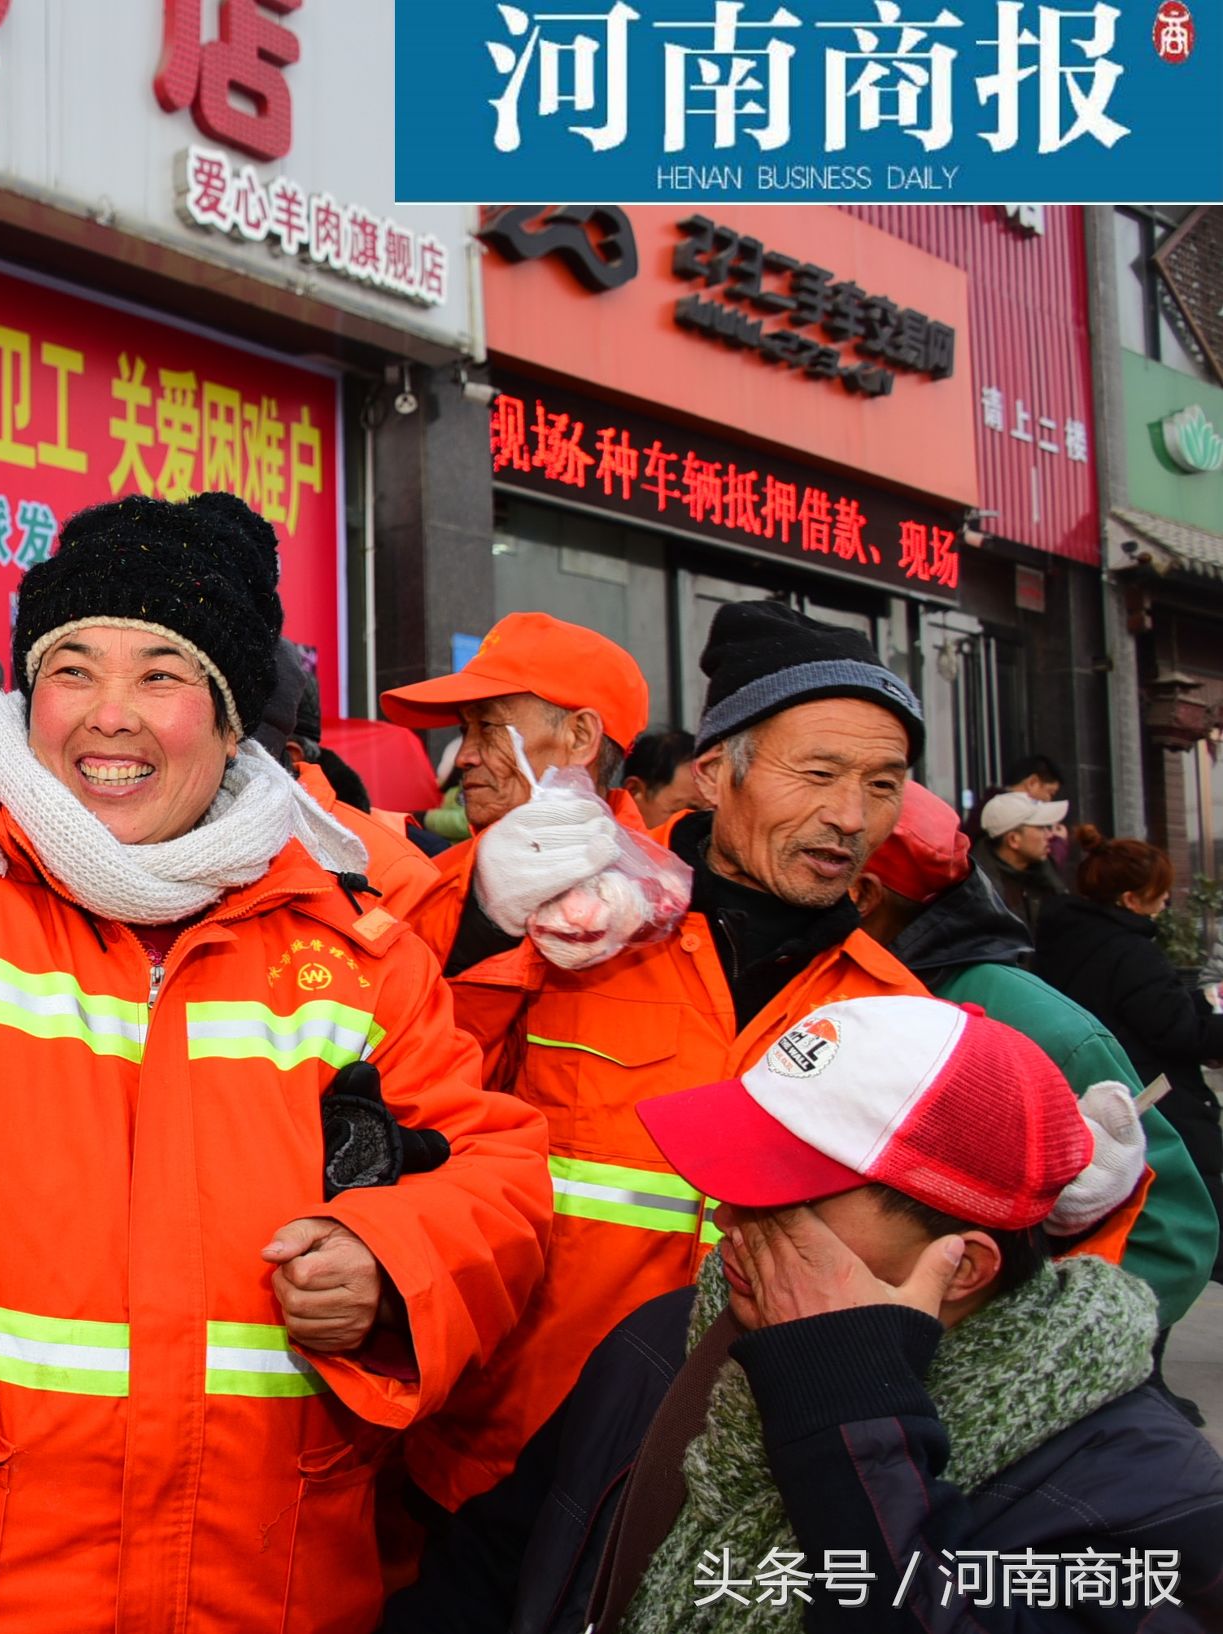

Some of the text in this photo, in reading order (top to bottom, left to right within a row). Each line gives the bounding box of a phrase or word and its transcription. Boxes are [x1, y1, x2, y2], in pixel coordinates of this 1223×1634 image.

[187, 149, 448, 304] 爱心羊肉旗舰店
[671, 213, 956, 382] 273二手车交易网
[108, 351, 323, 537] 关爱困难户
[981, 385, 1088, 463] 请上二楼
